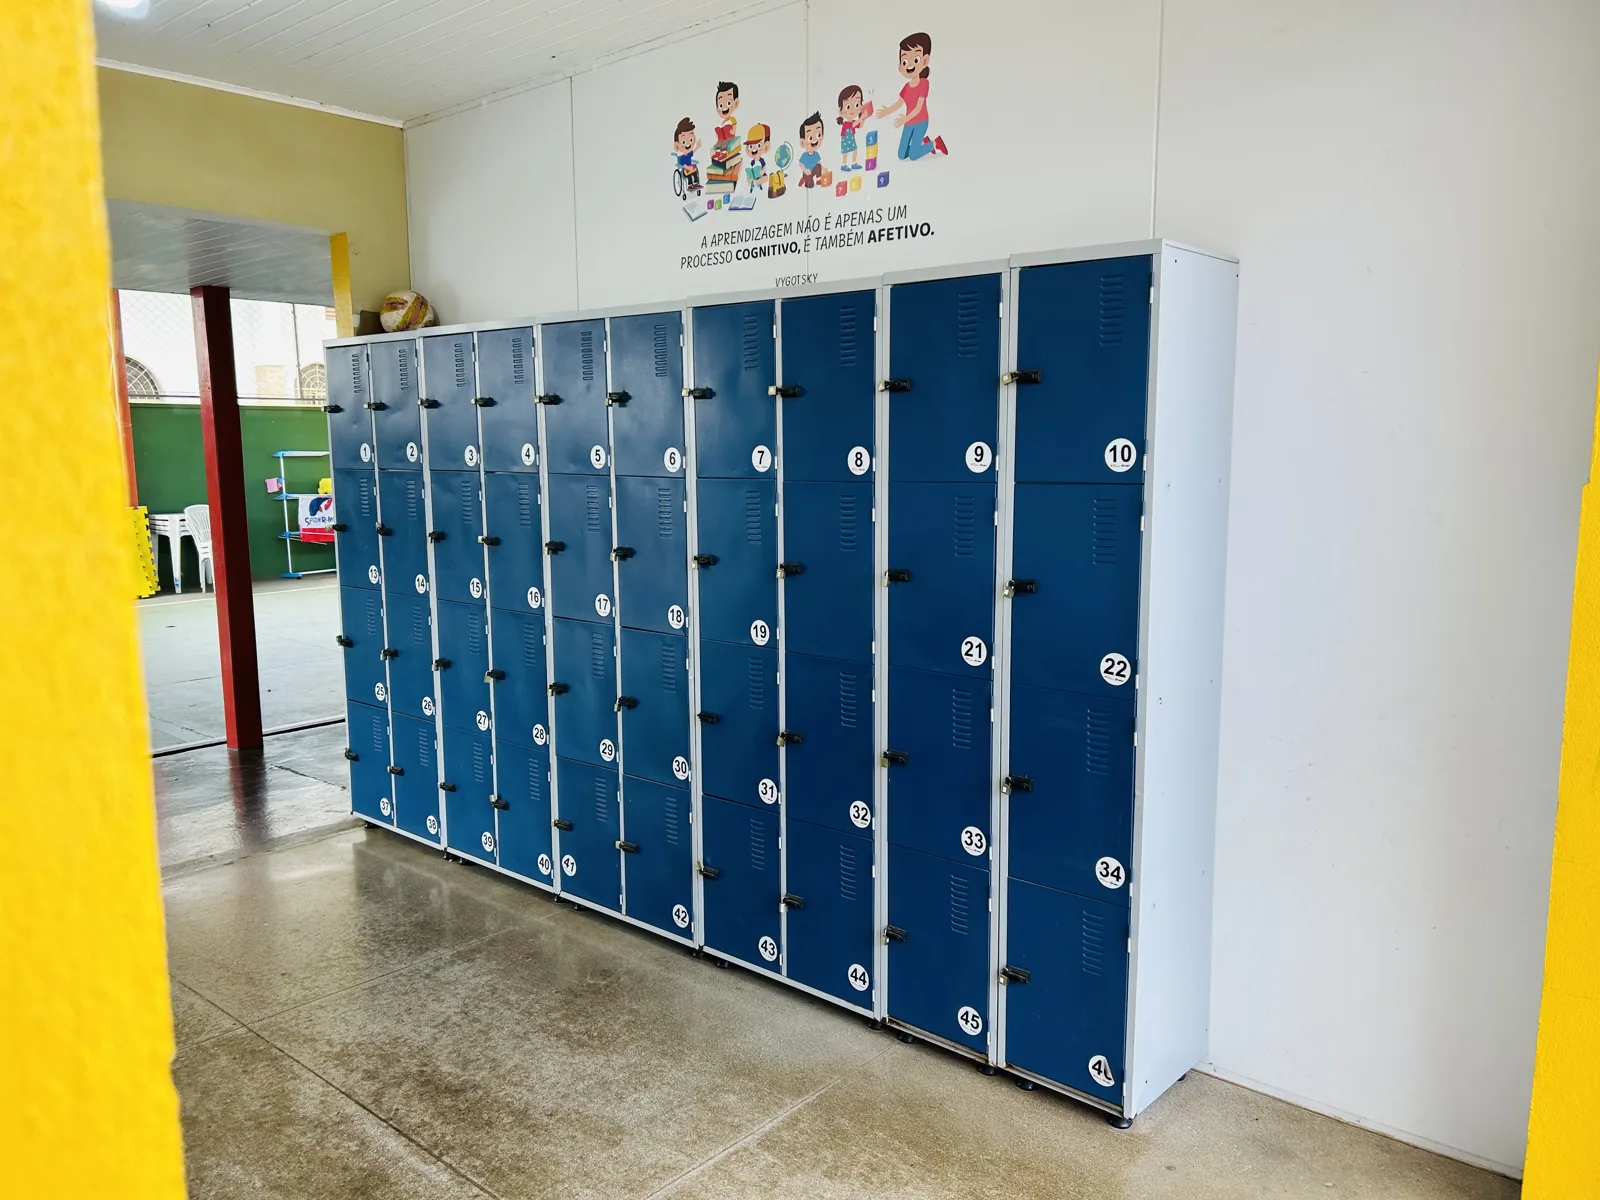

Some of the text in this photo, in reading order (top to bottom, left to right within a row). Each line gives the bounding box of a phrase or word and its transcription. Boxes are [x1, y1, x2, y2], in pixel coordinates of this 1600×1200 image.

[701, 204, 907, 249] A APRENDIZAGEM NÃO É APENAS UM
[680, 222, 935, 269] PROCESSO COGNITIVO, É TAMBÉM AFETIVO.
[775, 273, 818, 287] VYGOTSKY
[525, 447, 531, 459] 4
[595, 449, 601, 462] 5
[669, 451, 676, 466] 6
[757, 450, 765, 465] 7
[855, 451, 863, 467] 8
[974, 445, 984, 463] 9
[1109, 444, 1132, 463] 10
[370, 568, 378, 579] 13
[417, 578, 426, 588] 14
[471, 581, 480, 593] 15
[529, 591, 539, 603] 16
[597, 597, 608, 610] 17
[670, 608, 682, 623] 18
[753, 624, 767, 639] 19
[964, 641, 982, 659] 21
[1103, 658, 1127, 678] 22
[376, 685, 384, 696] 25
[424, 699, 432, 711] 26
[477, 713, 486, 725] 27
[534, 727, 544, 740] 28
[602, 742, 613, 756] 29
[675, 759, 687, 774] 30
[761, 782, 774, 798] 31
[381, 800, 389, 811] 37
[853, 805, 868, 822] 32
[428, 818, 436, 830] 38
[483, 834, 492, 847] 39
[964, 830, 983, 849] 33
[539, 857, 549, 870] 40
[563, 858, 574, 872] 41
[1099, 861, 1122, 882] 34
[674, 907, 688, 924] 42
[760, 940, 775, 956] 43
[850, 968, 867, 986] 44
[960, 1010, 980, 1030] 45
